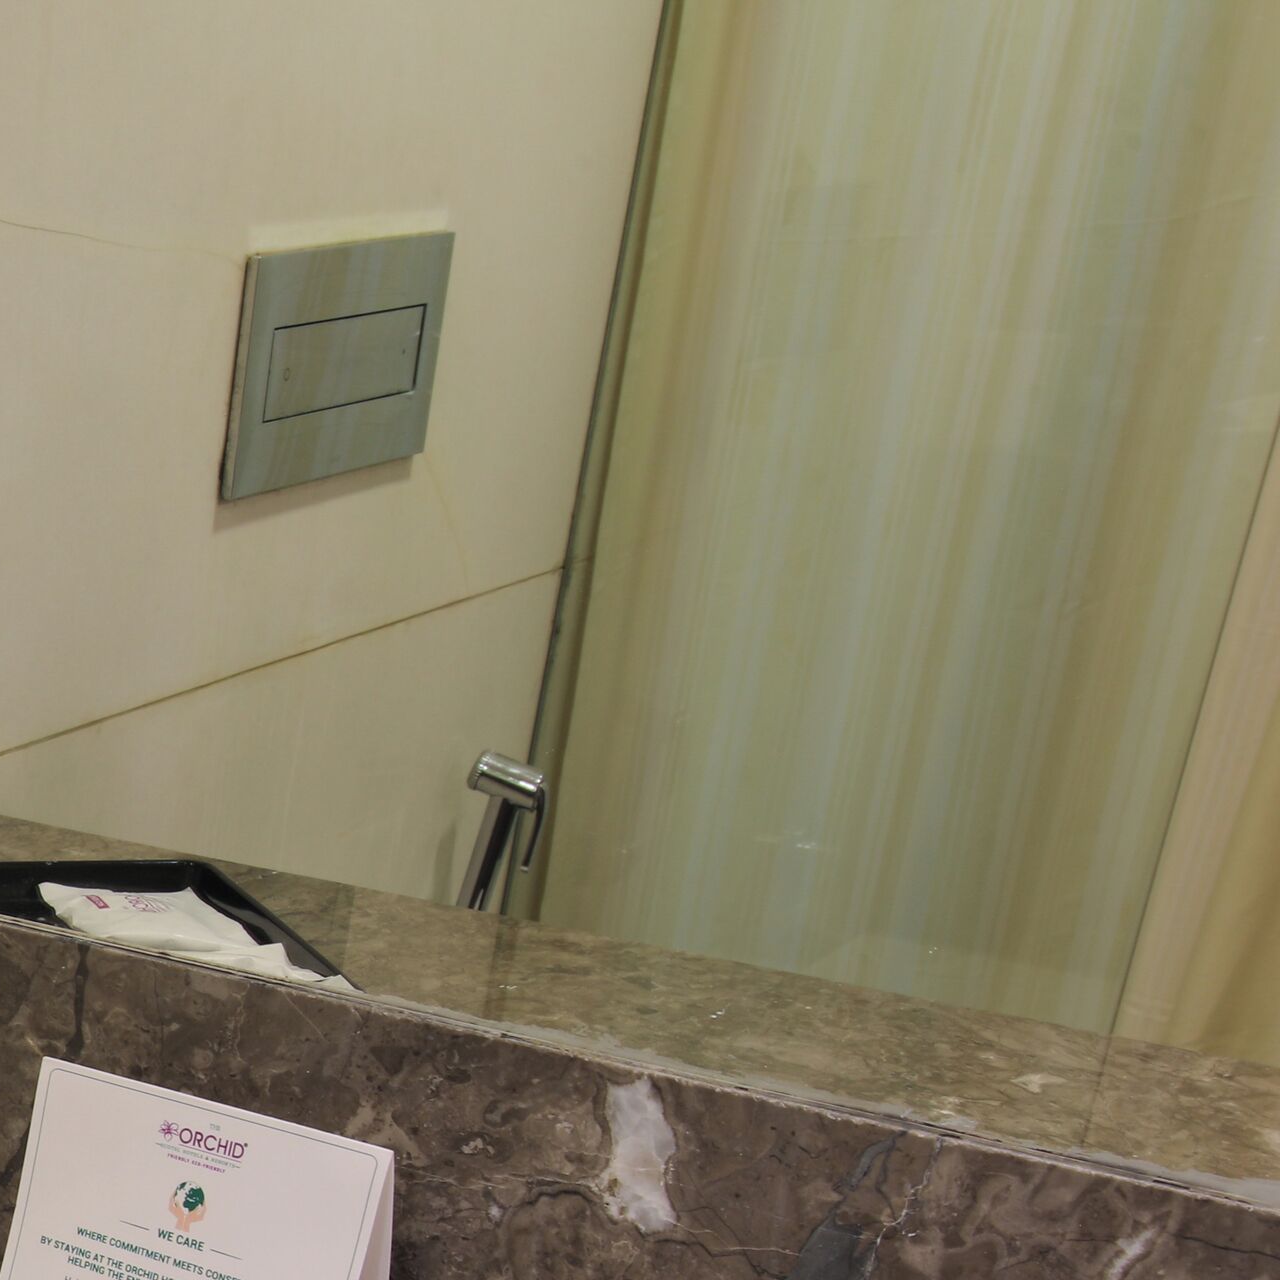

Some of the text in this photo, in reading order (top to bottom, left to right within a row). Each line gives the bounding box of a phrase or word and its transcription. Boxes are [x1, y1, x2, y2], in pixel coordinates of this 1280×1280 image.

[76, 1226, 107, 1244] WHERE
[108, 1237, 171, 1264] COMMITMENT
[172, 1257, 203, 1275] MEETS
[157, 1228, 204, 1251] WE CARE
[40, 1235, 53, 1245] BY
[53, 1239, 91, 1259] STAYING
[92, 1253, 105, 1263] AT
[106, 1256, 123, 1270] THE
[124, 1263, 159, 1280] ORCHID
[67, 1255, 105, 1274] HELPING
[107, 1267, 124, 1280] THE
